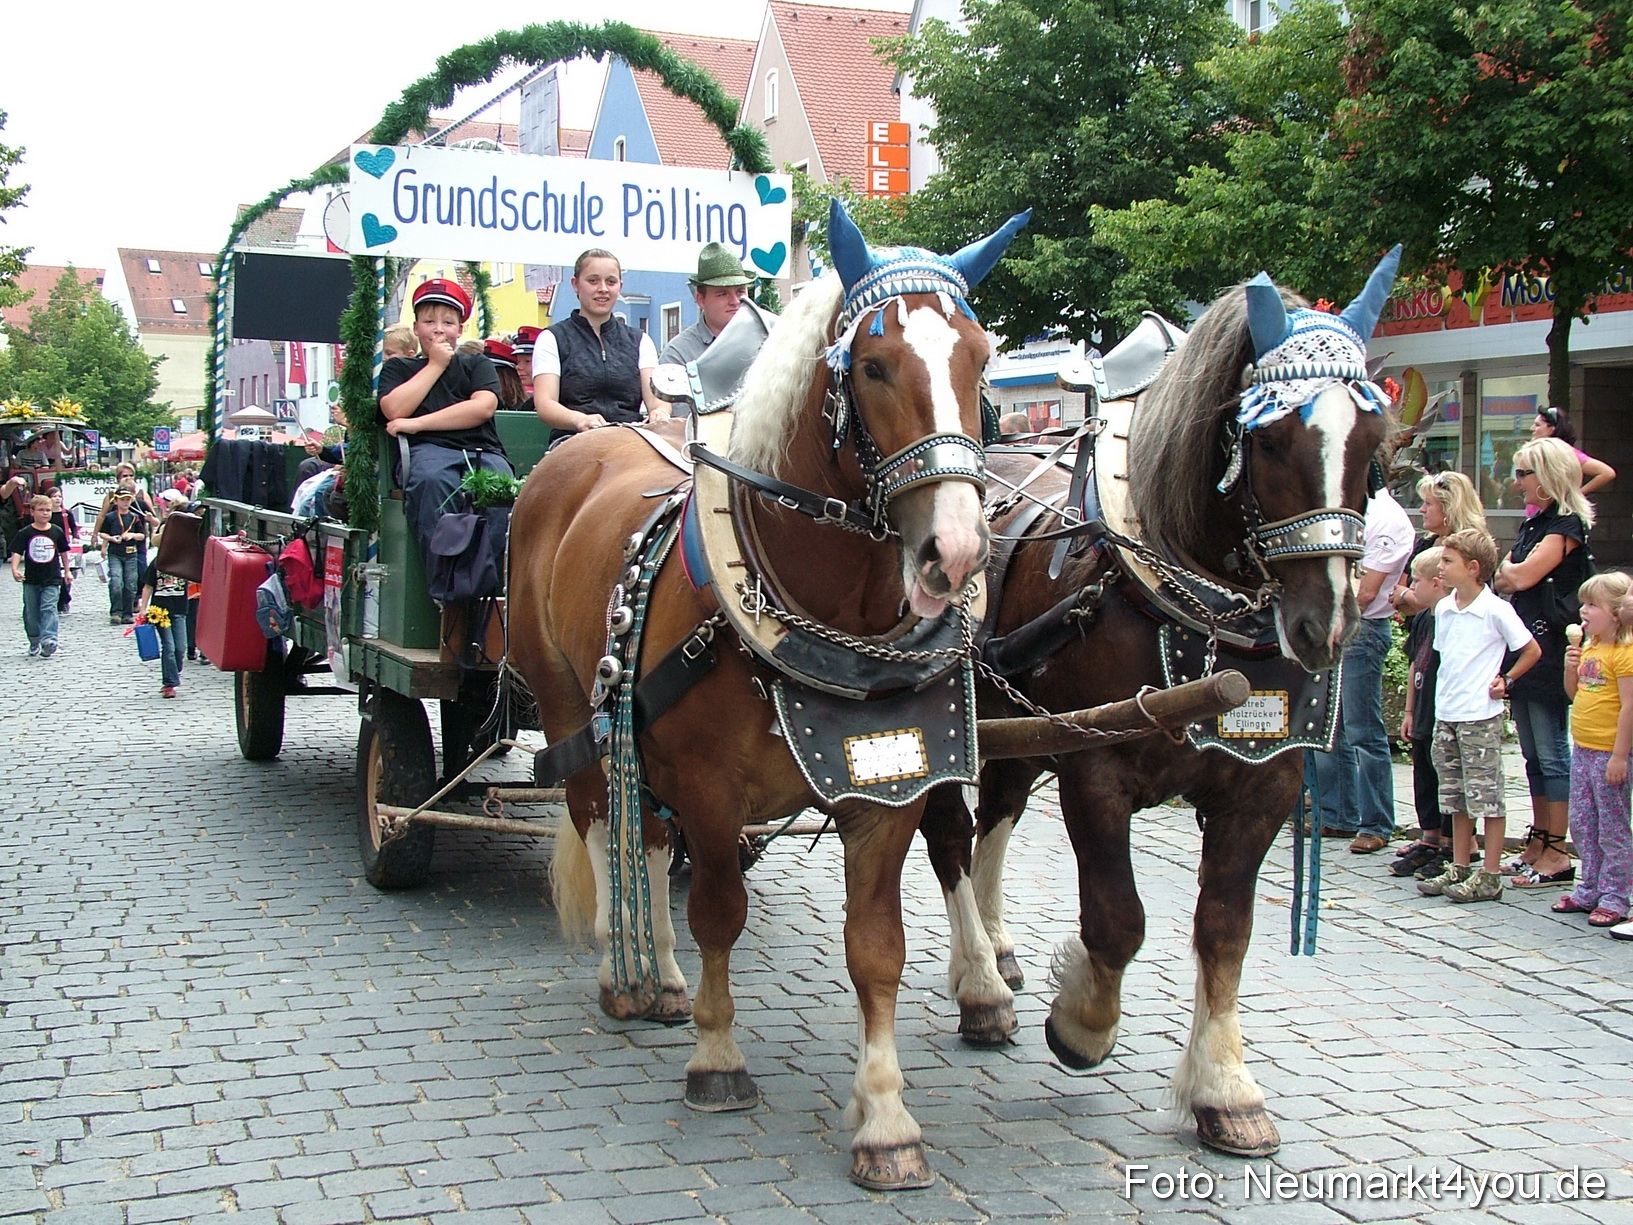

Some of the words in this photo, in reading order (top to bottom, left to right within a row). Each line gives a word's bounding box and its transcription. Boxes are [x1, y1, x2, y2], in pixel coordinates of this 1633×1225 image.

[872, 121, 892, 200] ELE
[392, 168, 606, 237] Grundschule
[622, 182, 748, 261] Pölling
[156, 443, 169, 451] TAXI
[79, 477, 100, 485] WEST
[1229, 709, 1277, 718] Holzrücker
[1235, 719, 1271, 730] Ellingen
